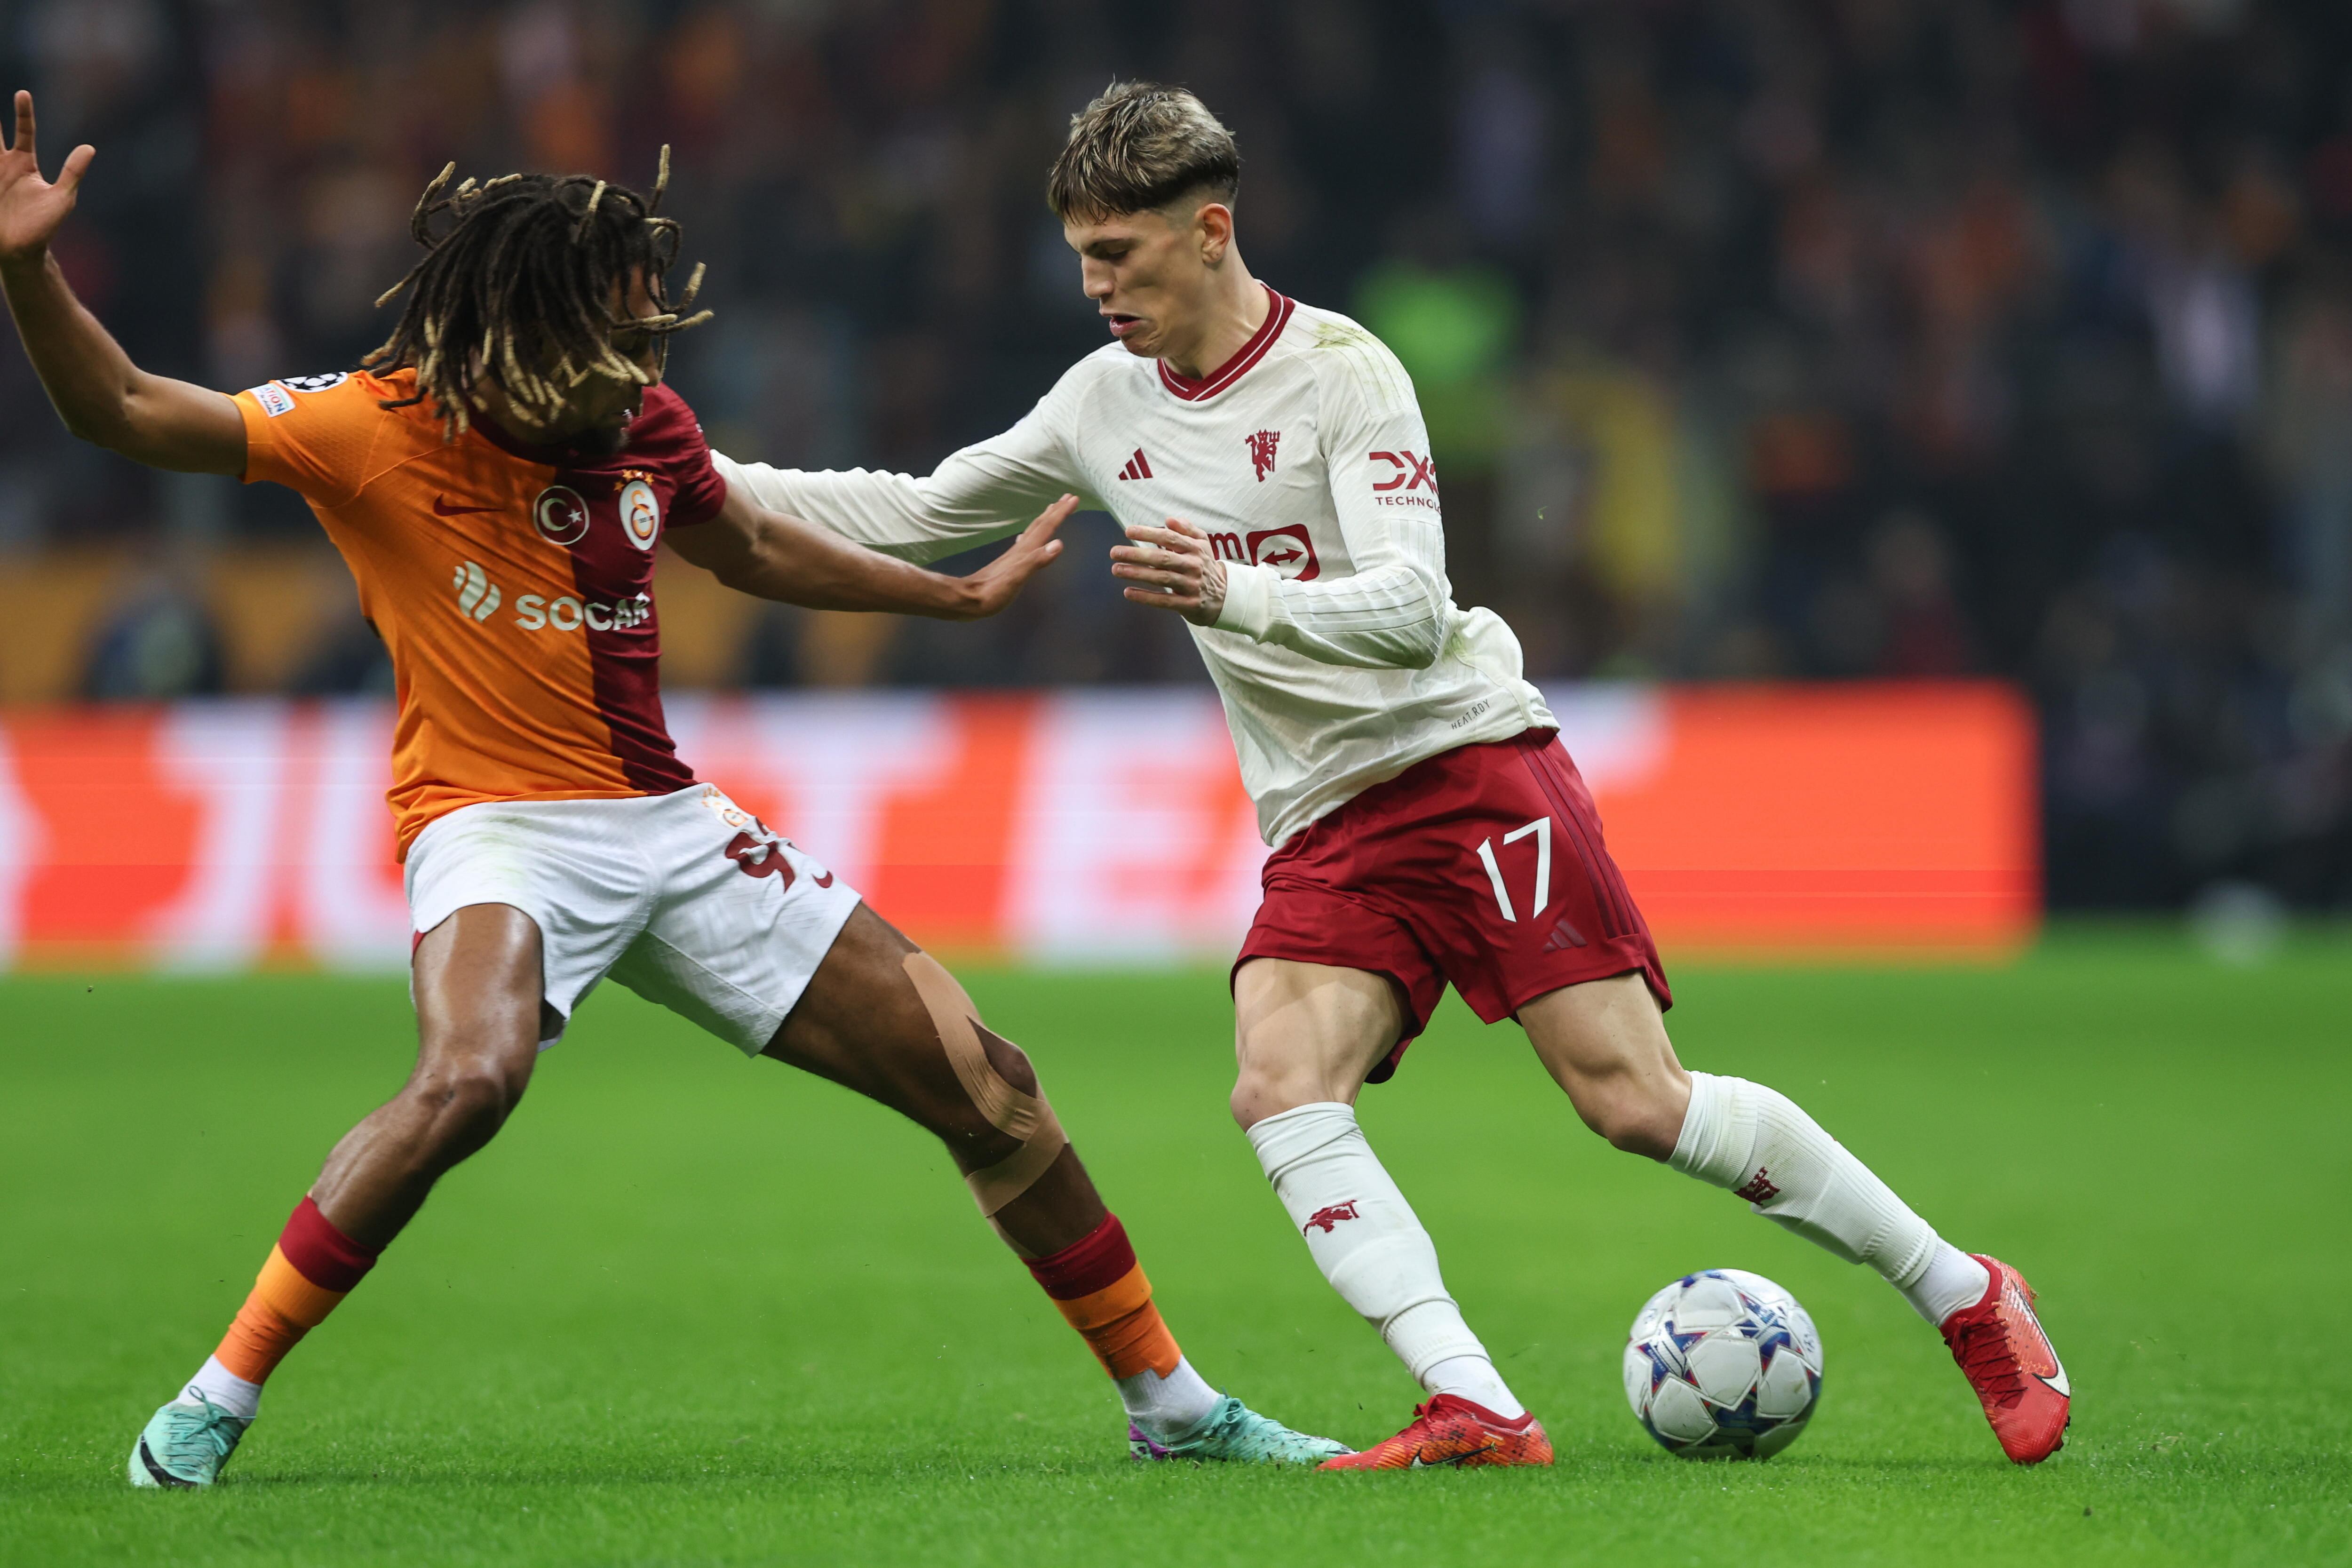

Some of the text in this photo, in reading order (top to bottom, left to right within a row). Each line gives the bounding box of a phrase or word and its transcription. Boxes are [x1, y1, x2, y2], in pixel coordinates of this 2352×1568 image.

[515, 592, 651, 631] SOCAR
[725, 816, 796, 894] 9
[1476, 816, 1551, 923] 17
